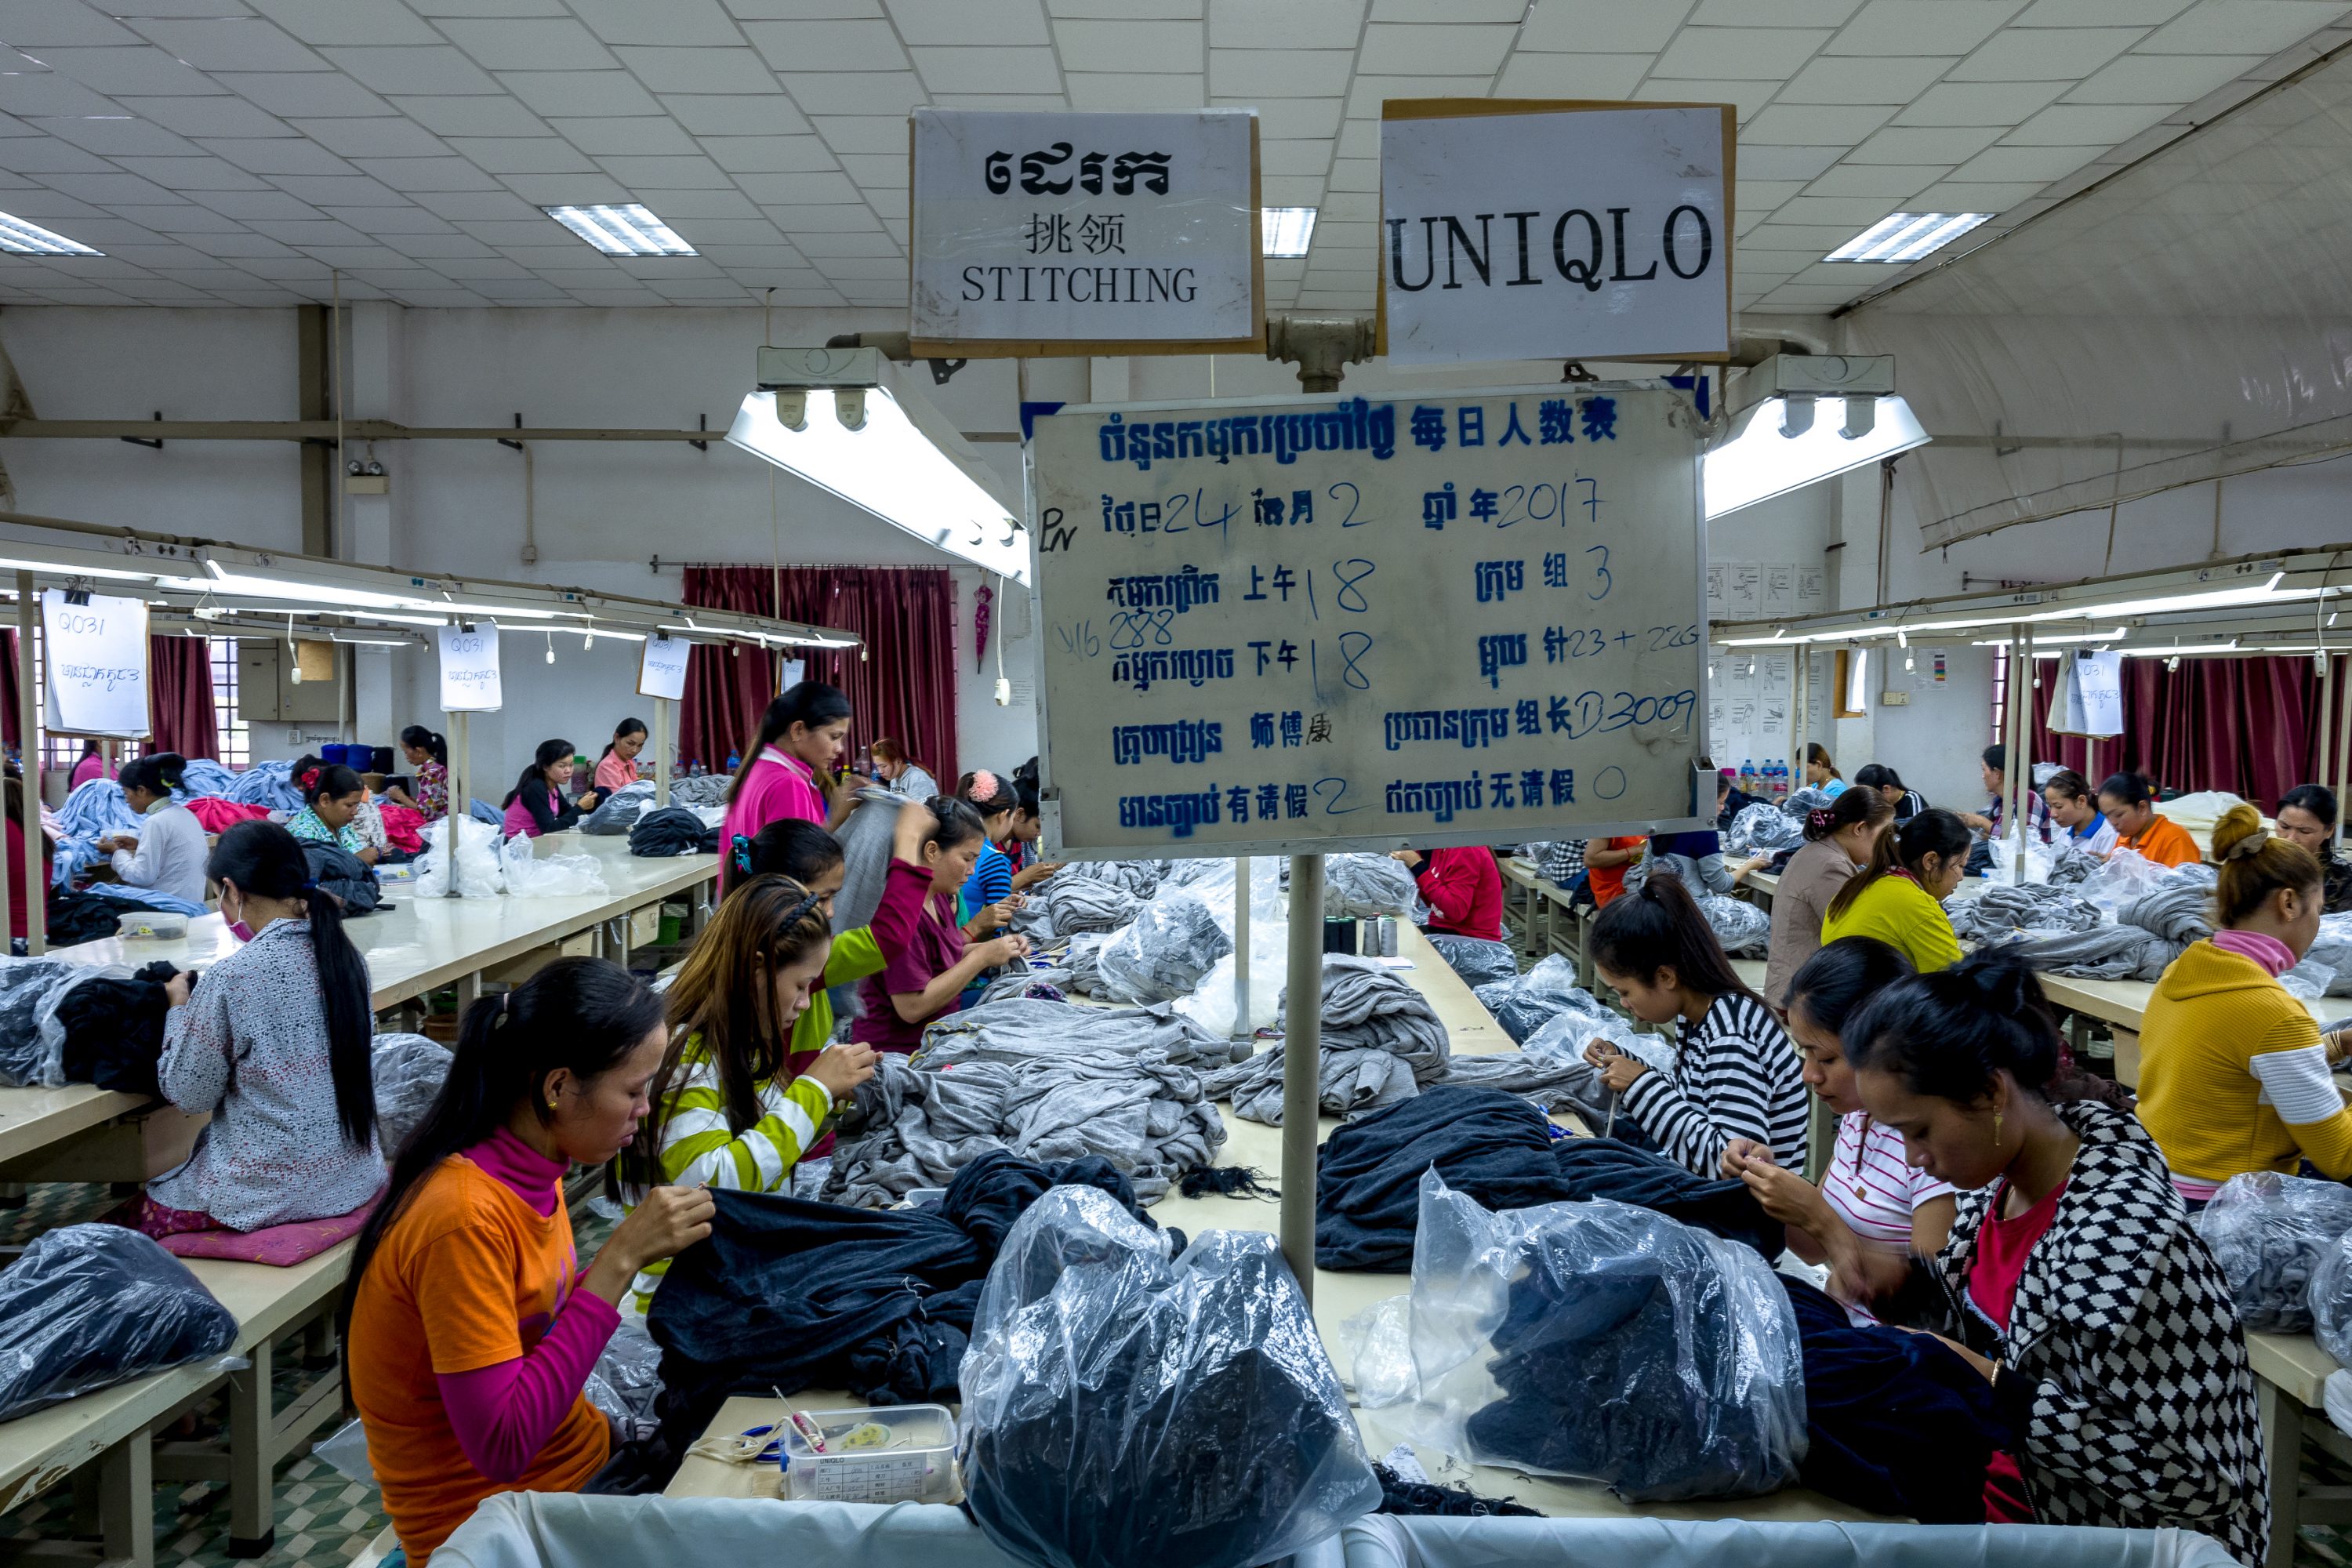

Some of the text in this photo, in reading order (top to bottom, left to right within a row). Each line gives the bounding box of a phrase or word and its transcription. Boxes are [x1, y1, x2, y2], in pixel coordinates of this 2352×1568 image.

[985, 141, 1173, 196] ដេរក
[1024, 212, 1127, 256] 挑领
[1385, 204, 1713, 292] UNIQLO
[961, 266, 1199, 303] STITCHING
[1410, 396, 1617, 452] 每日人数表
[1164, 488, 1243, 541] 24
[1329, 482, 1378, 528] 2
[1469, 488, 1499, 524] 年
[1496, 478, 1607, 528] 2017
[1243, 564, 1297, 602] 上午
[1306, 558, 1376, 622] 18
[1543, 551, 1568, 588] 组
[1585, 545, 1613, 601] 3
[59, 612, 105, 636] Q031
[1543, 626, 1569, 664] 针
[1569, 629, 1606, 658] 23
[1247, 639, 1300, 677] 下午
[1310, 631, 1374, 699] 18
[1226, 782, 1308, 824] 有请假
[1312, 777, 1378, 815] 2
[1490, 768, 1576, 808] 无请假
